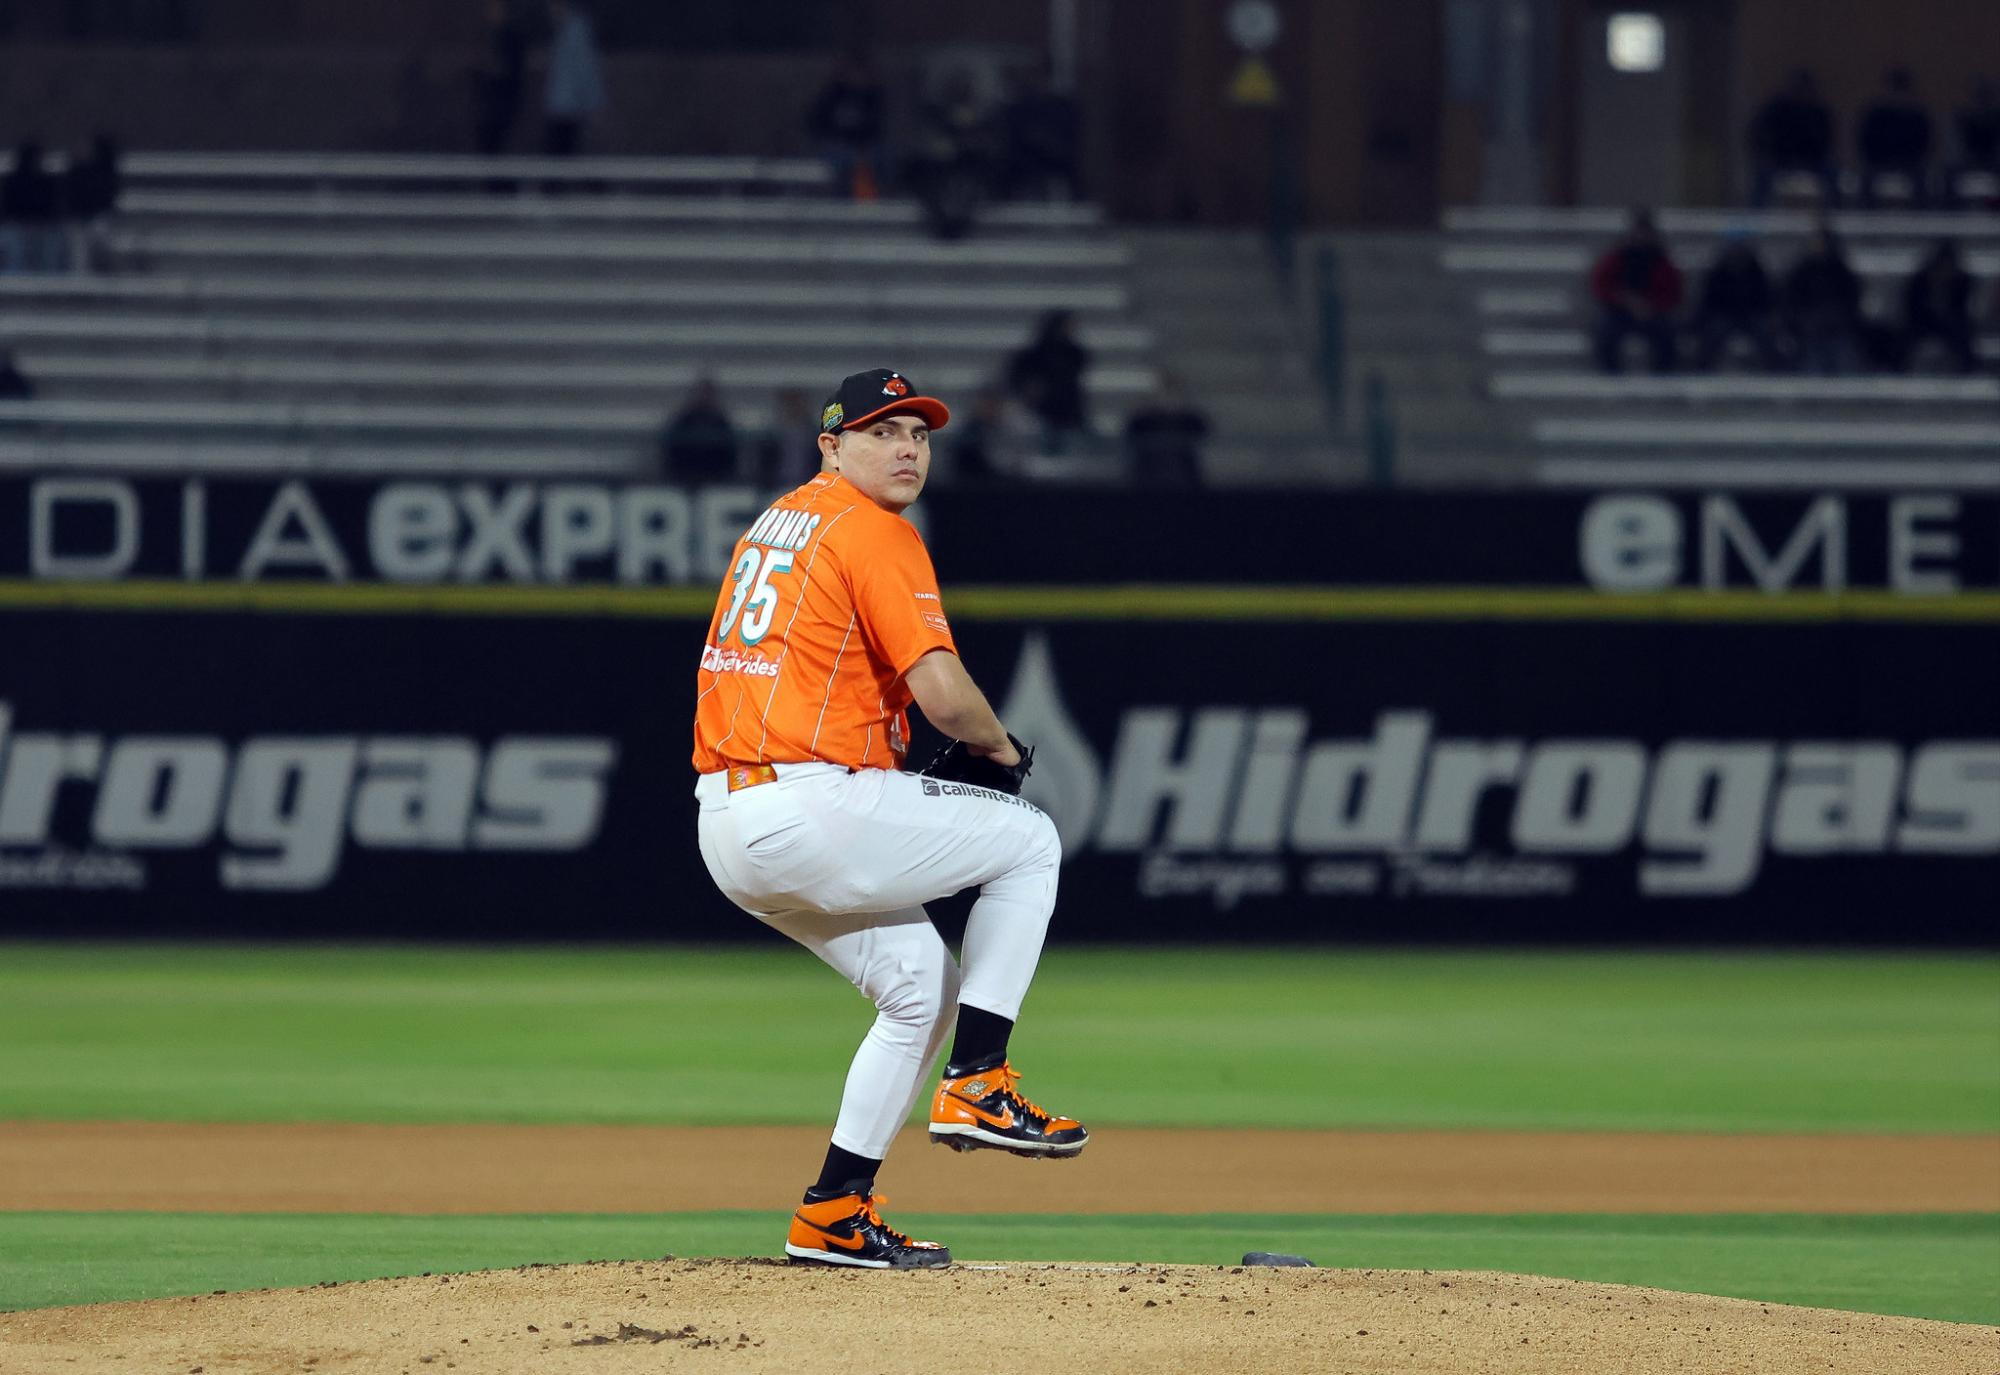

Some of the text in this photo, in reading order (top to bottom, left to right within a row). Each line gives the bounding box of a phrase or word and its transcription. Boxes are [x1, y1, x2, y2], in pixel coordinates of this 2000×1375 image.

[717, 545, 795, 647] 35
[0, 697, 618, 890] rogas
[1098, 707, 2000, 896] Hidrogas
